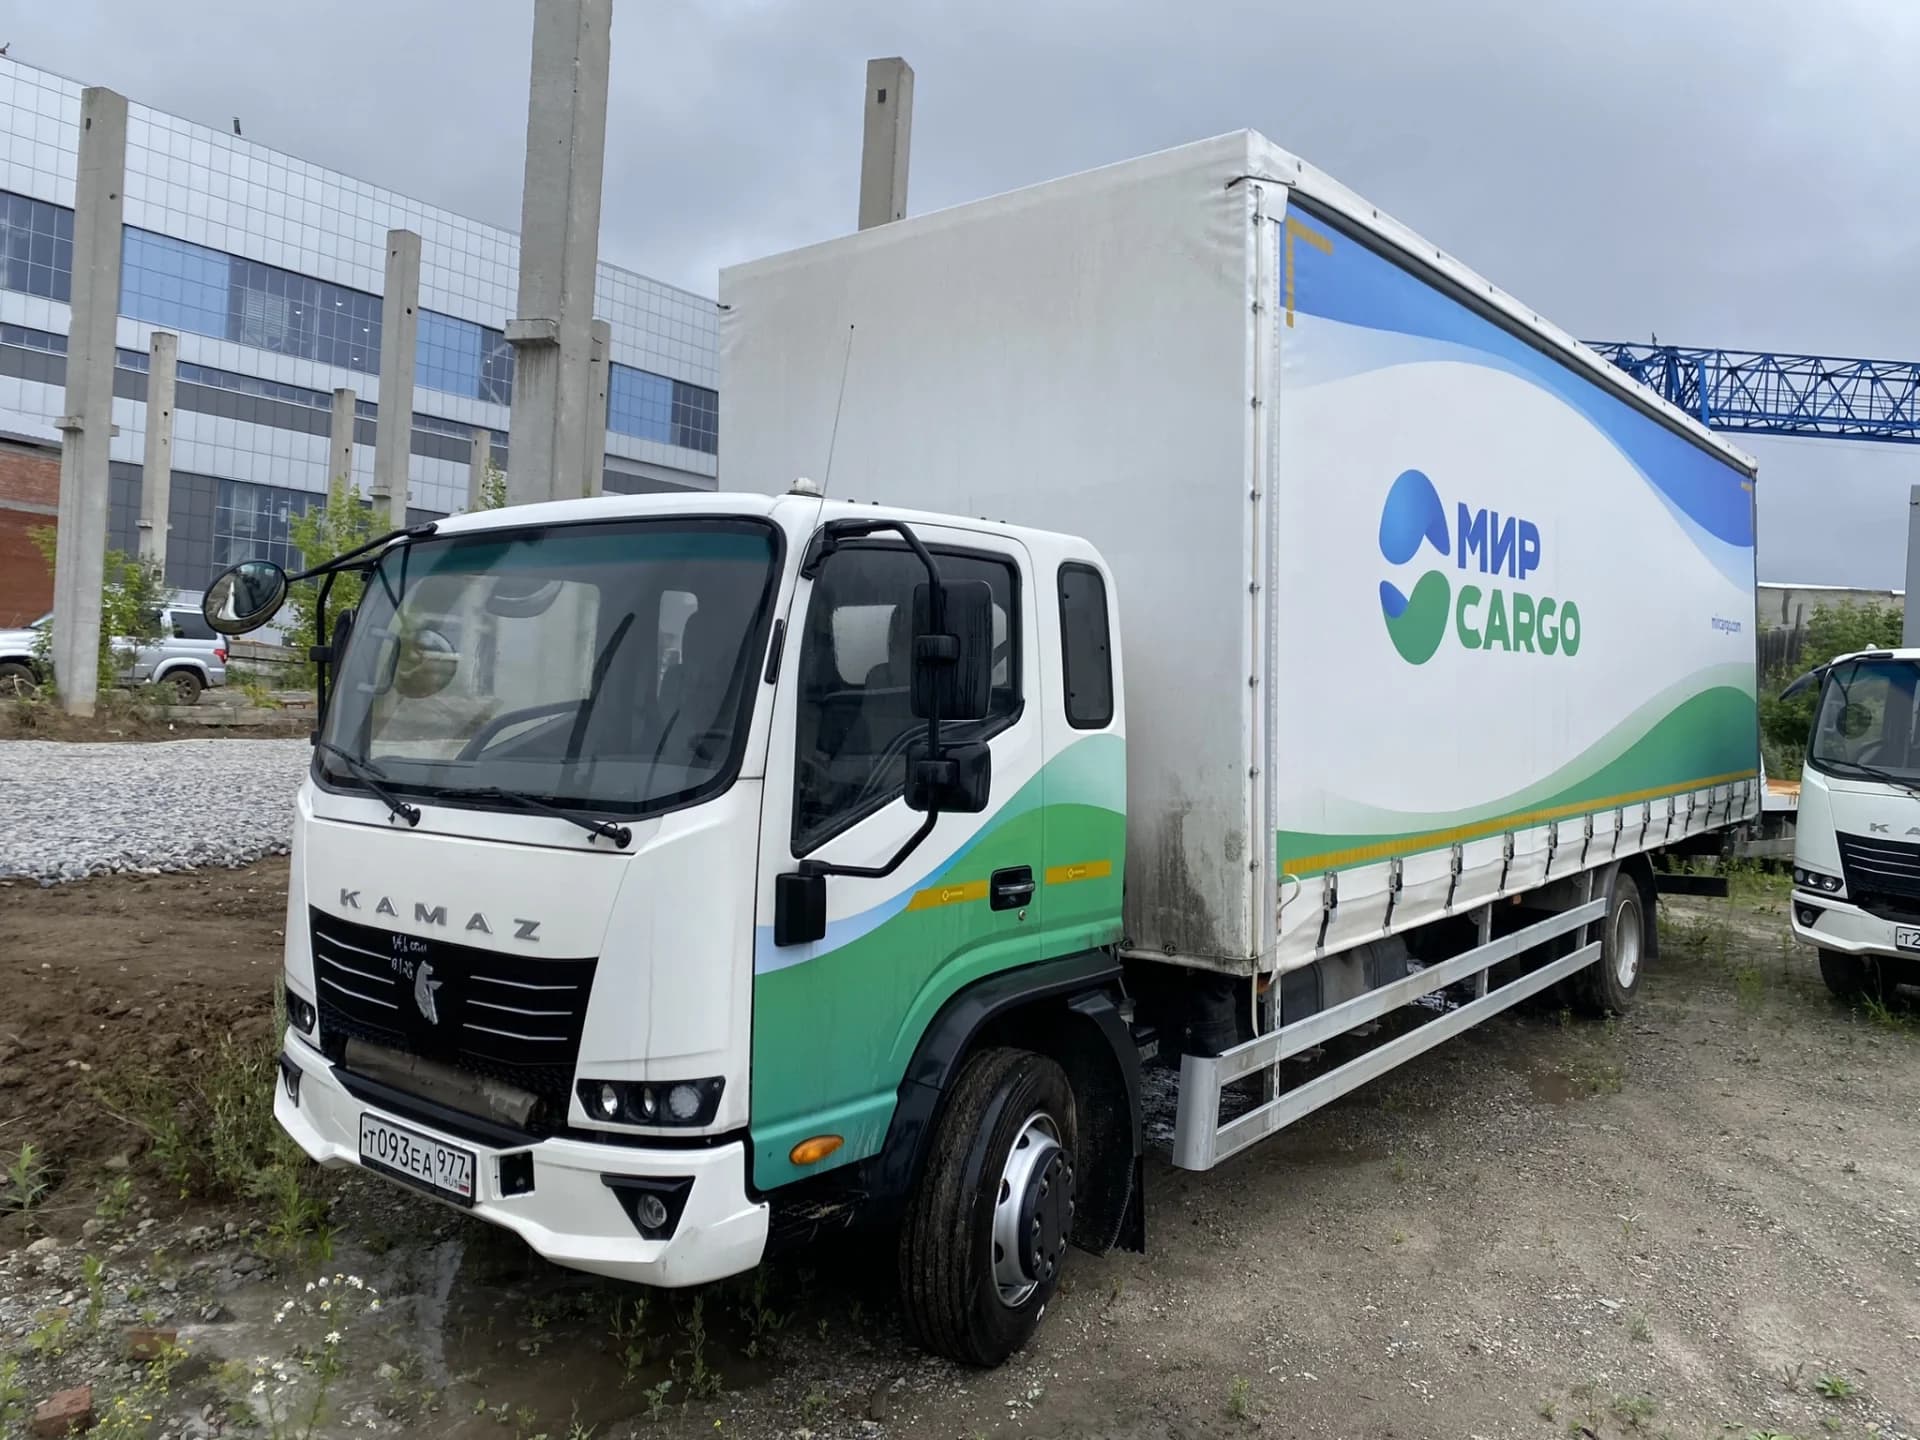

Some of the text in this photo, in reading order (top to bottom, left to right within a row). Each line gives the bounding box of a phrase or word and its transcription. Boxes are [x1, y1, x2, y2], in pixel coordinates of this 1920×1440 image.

[1458, 502, 1541, 580] МИР
[1456, 585, 1580, 656] CARGO
[339, 888, 541, 942] KAMAZ
[437, 1149, 466, 1179] 977
[443, 1175, 458, 1189] RUS
